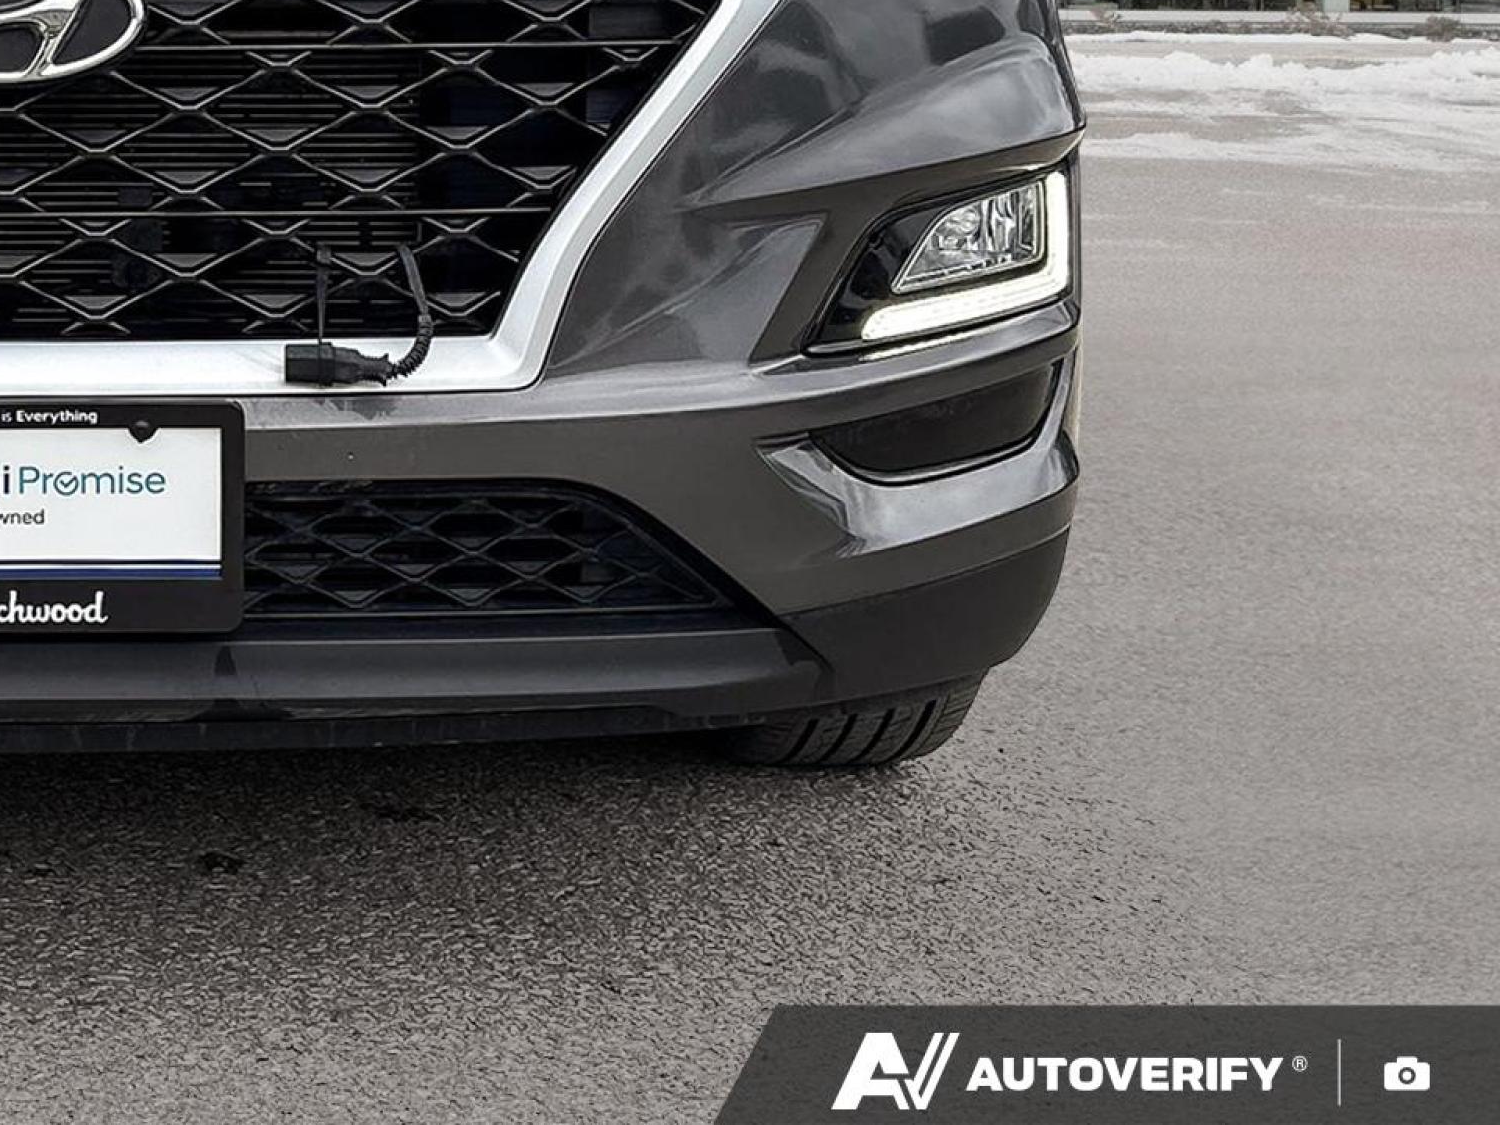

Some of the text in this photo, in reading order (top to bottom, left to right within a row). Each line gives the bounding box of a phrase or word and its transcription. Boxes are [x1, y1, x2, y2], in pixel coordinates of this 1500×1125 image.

[1, 412, 12, 423] is
[16, 410, 98, 425] Everything
[19, 466, 166, 496] Promise
